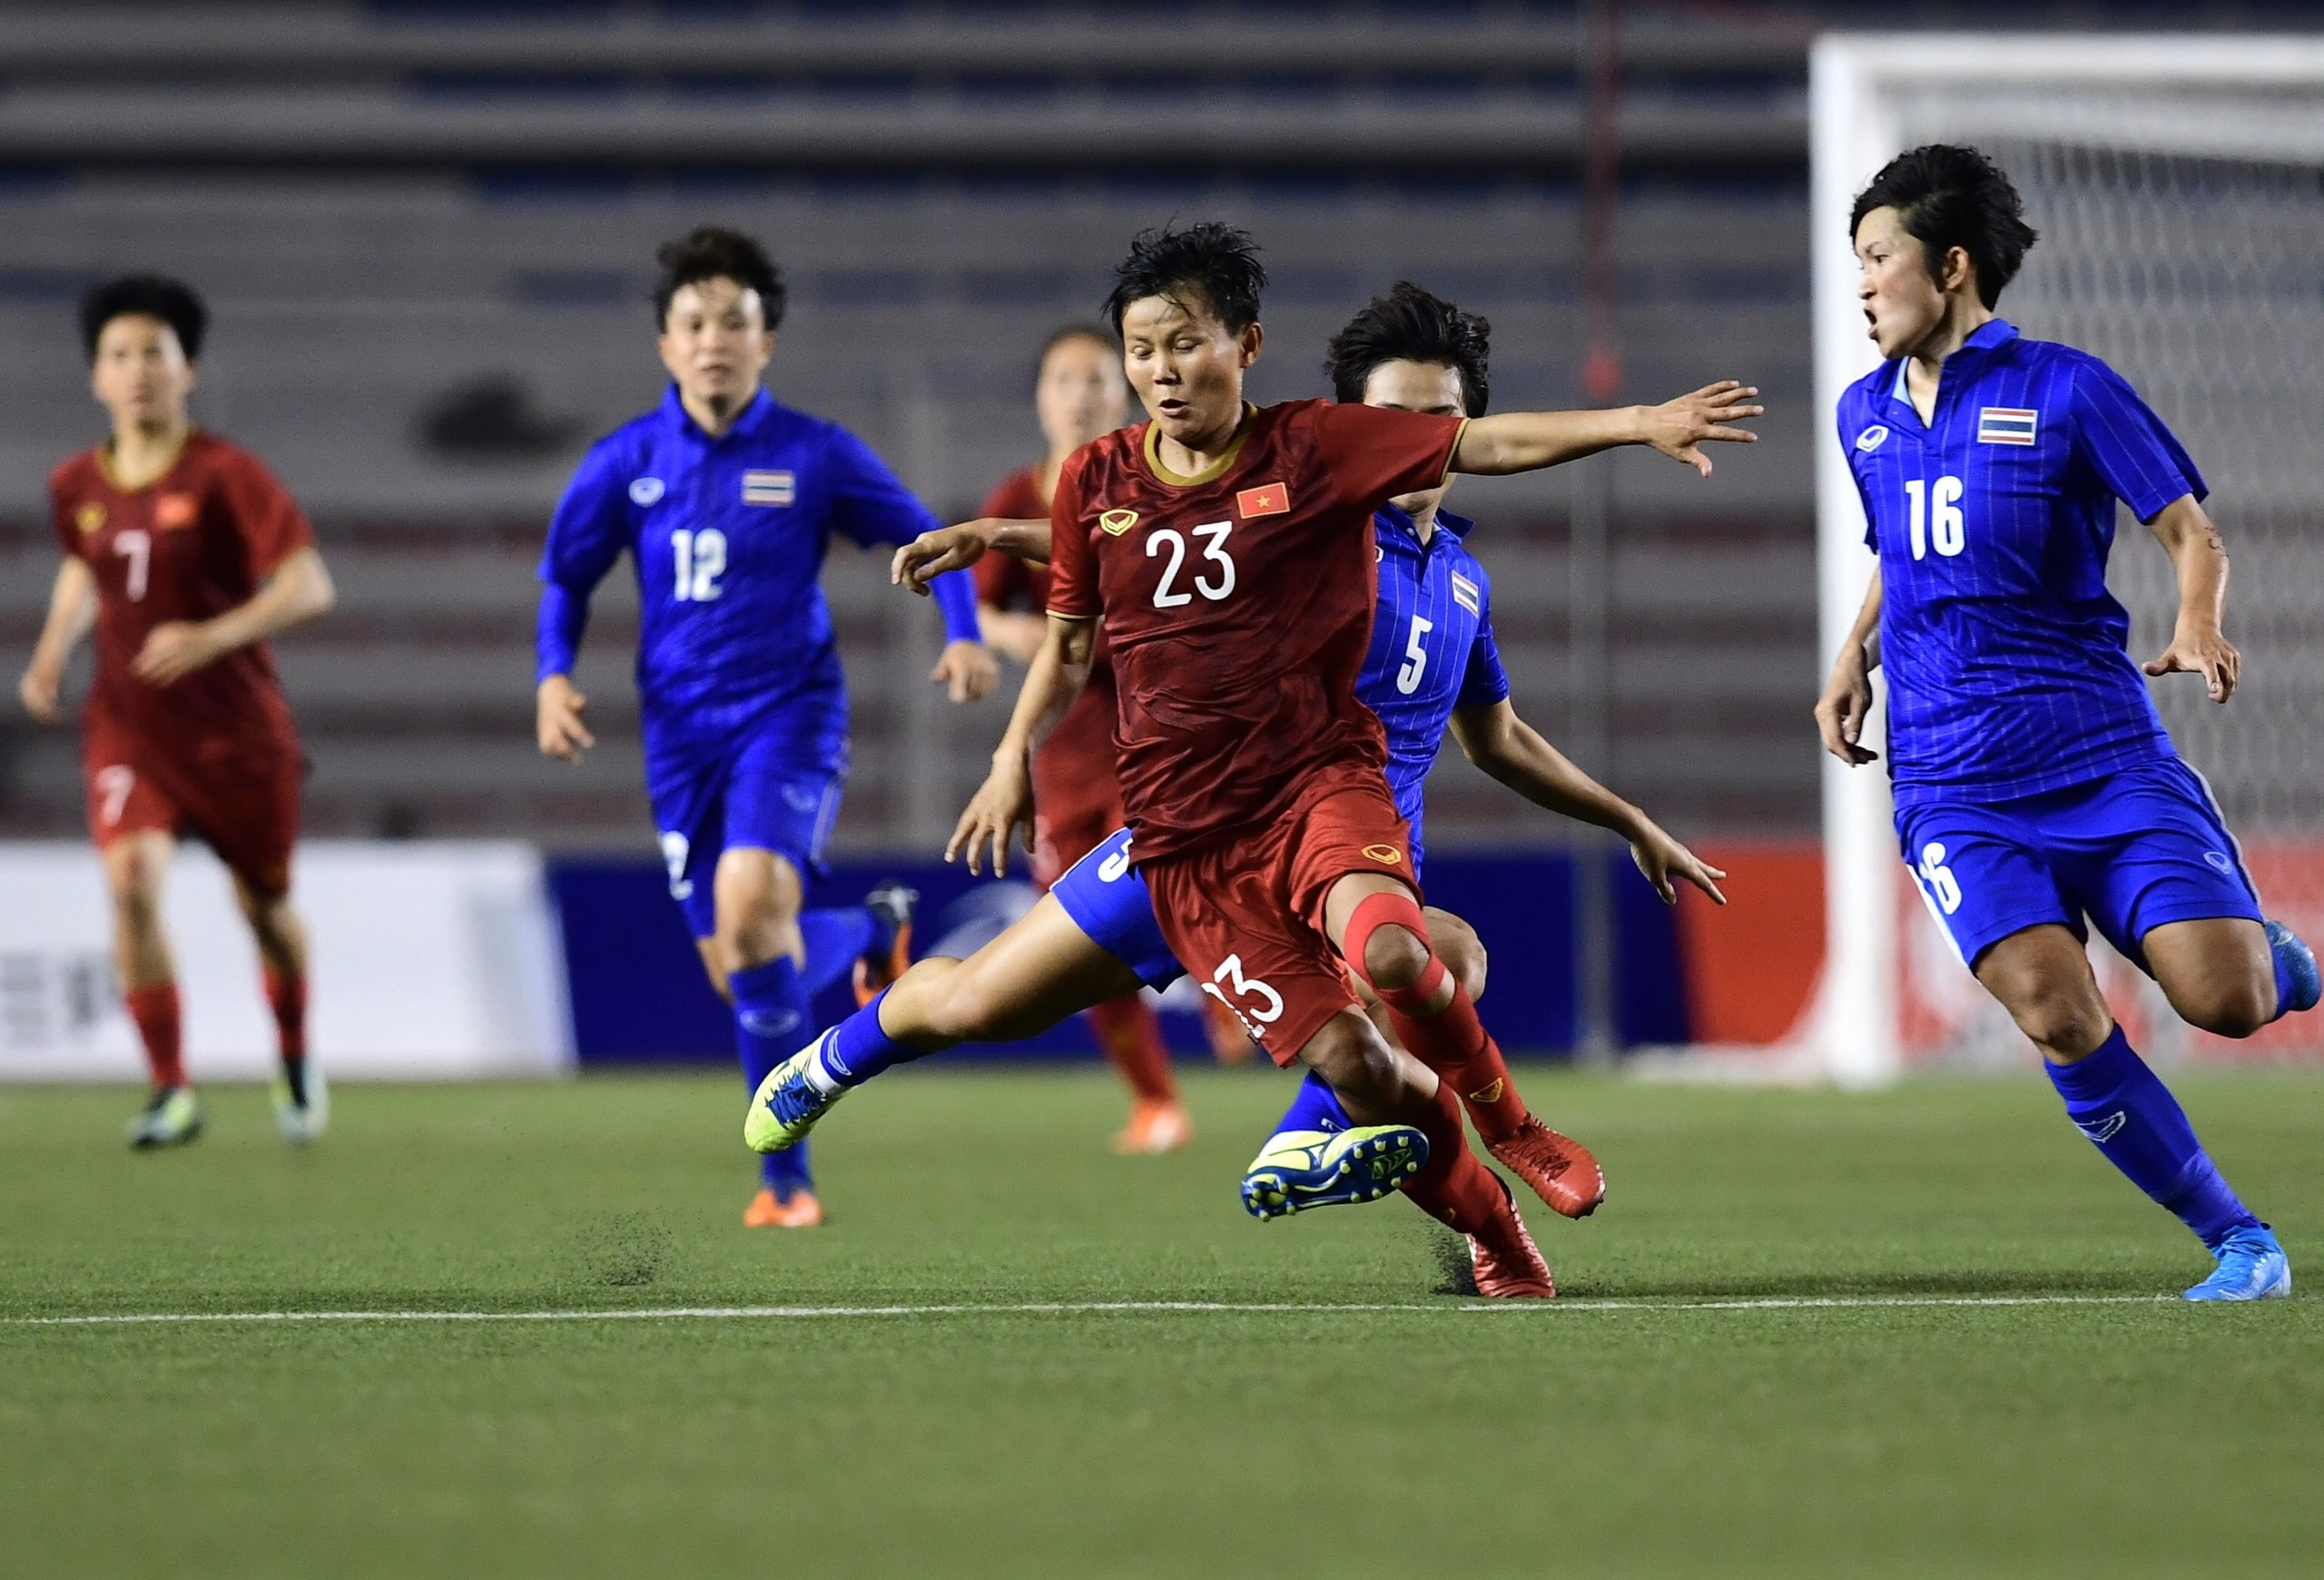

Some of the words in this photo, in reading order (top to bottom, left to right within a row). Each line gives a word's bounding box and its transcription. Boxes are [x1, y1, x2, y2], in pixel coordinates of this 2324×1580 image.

[1905, 475, 1965, 561] 16
[113, 529, 151, 601] 7
[670, 528, 727, 601] 12
[1146, 520, 1236, 608] 23
[1396, 613, 1433, 696] 5
[95, 764, 136, 826] 7
[1918, 842, 1963, 915] 6
